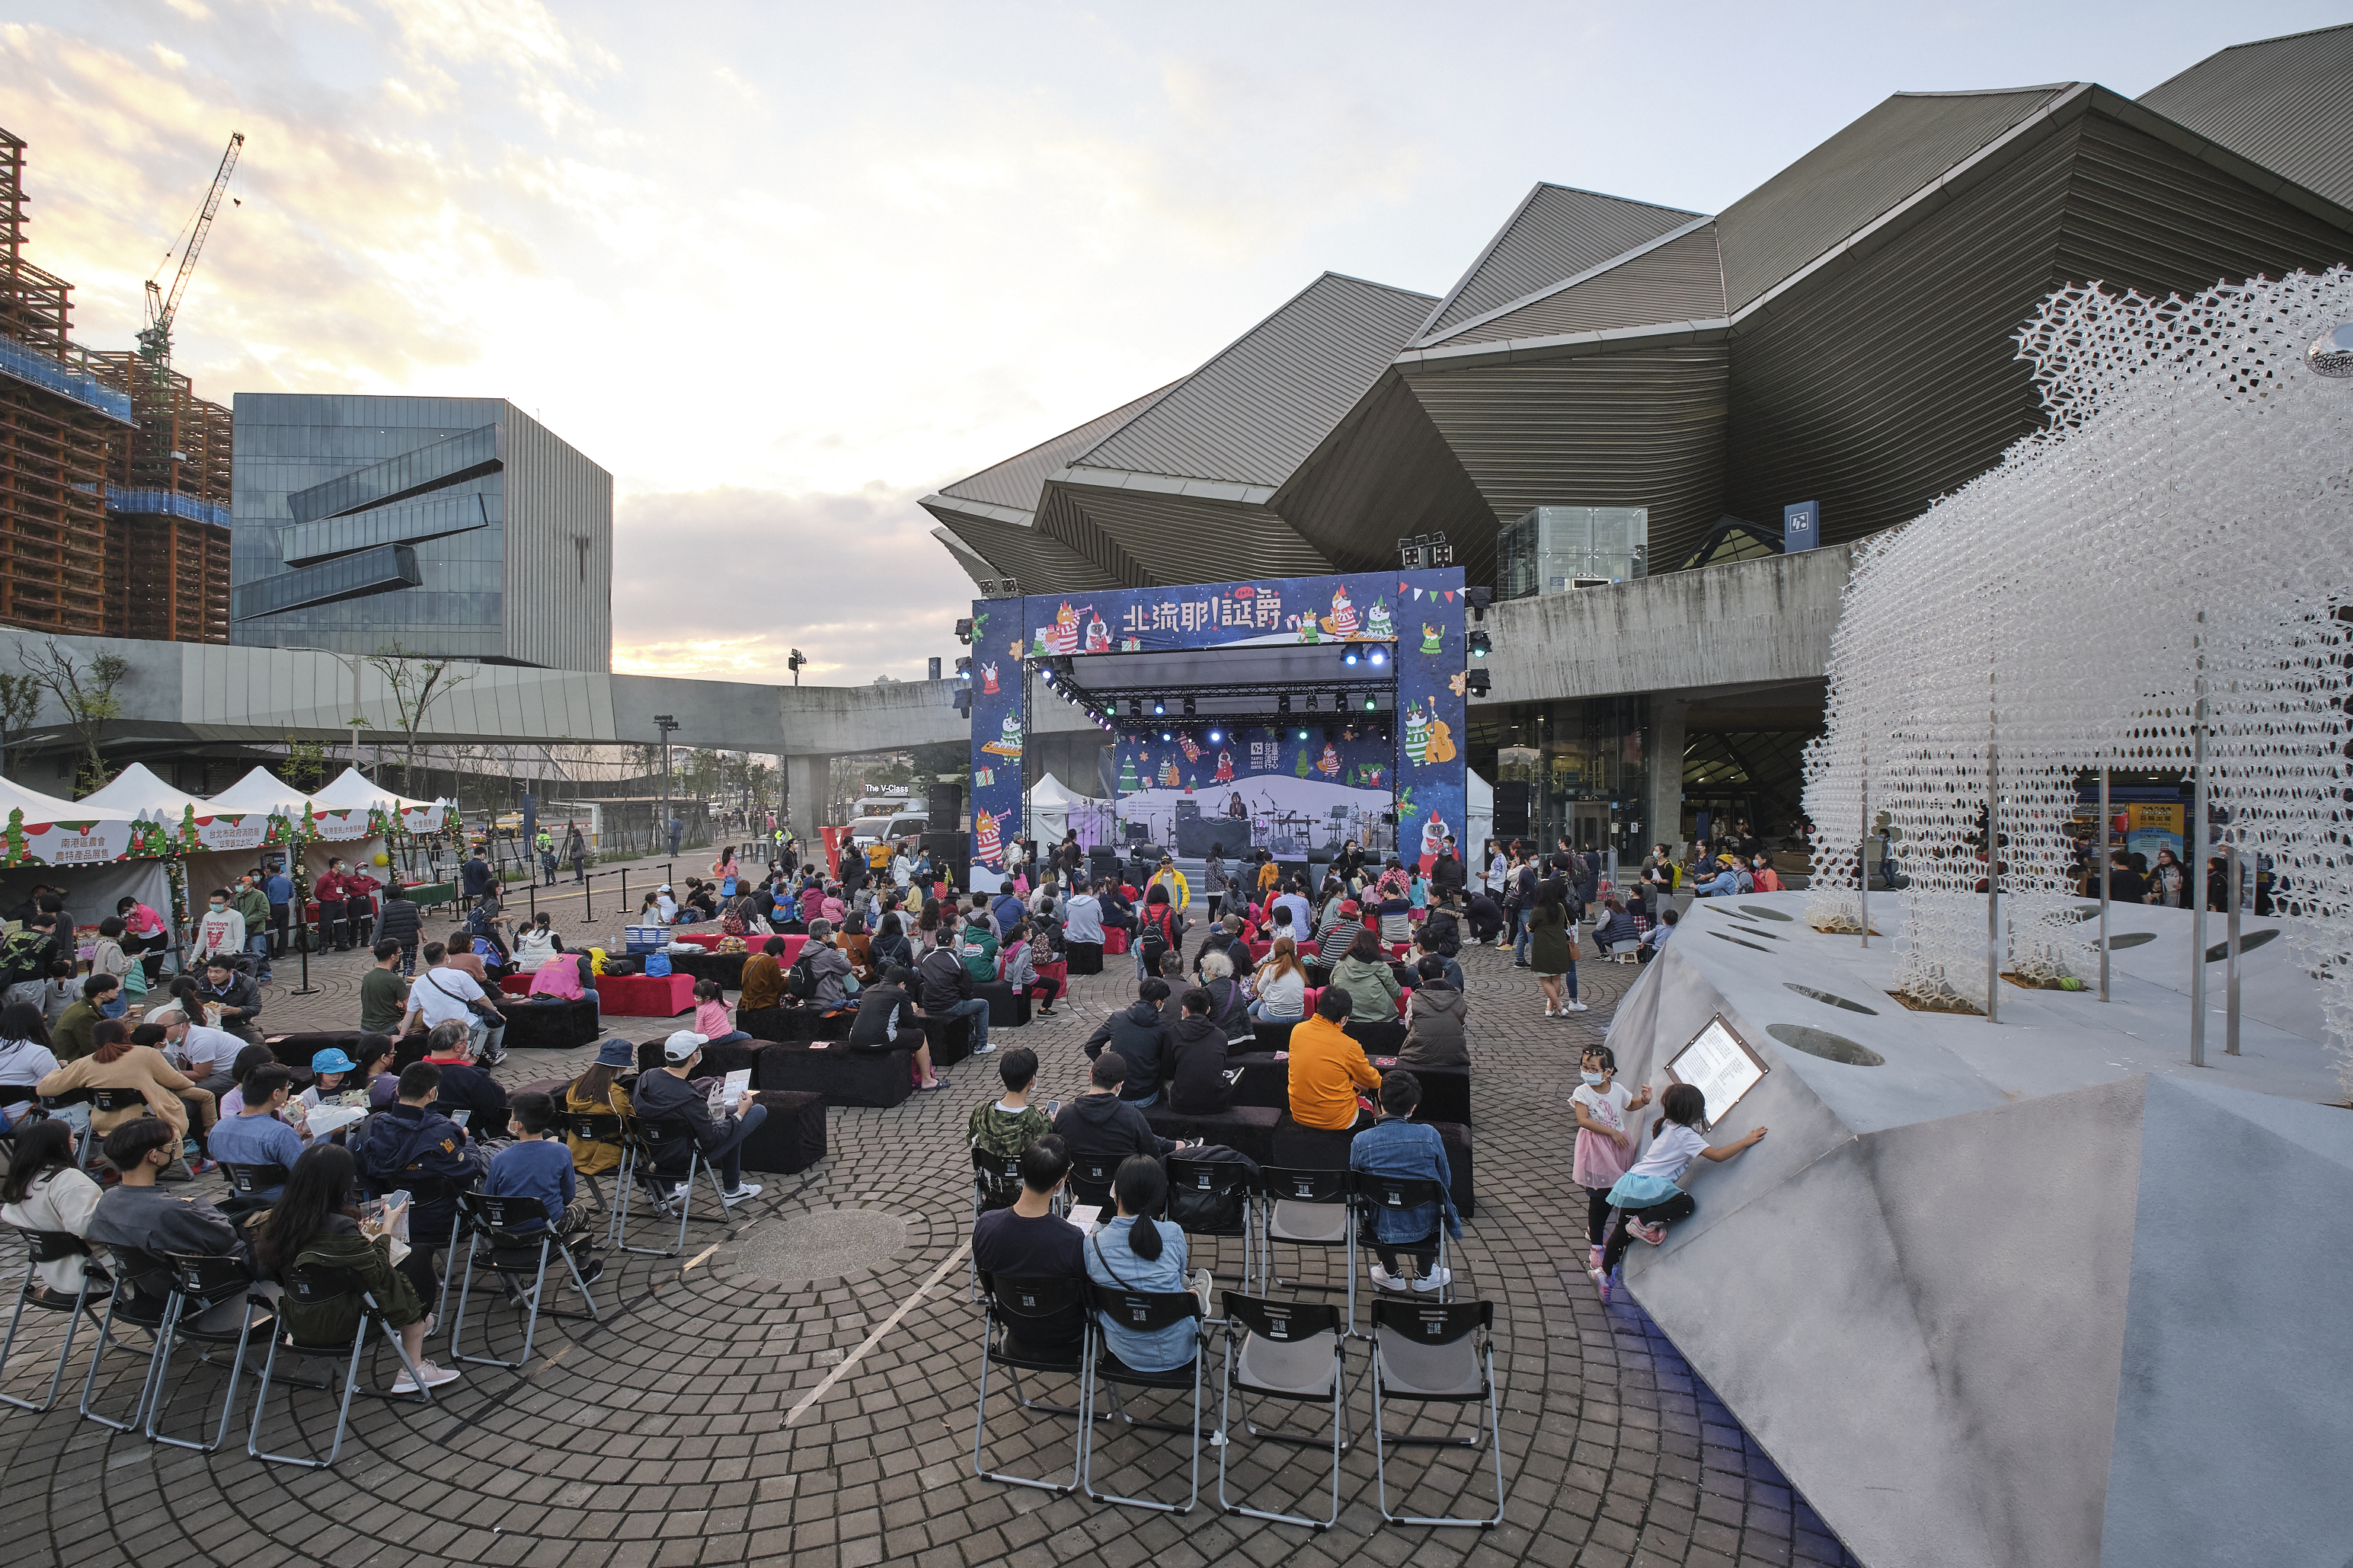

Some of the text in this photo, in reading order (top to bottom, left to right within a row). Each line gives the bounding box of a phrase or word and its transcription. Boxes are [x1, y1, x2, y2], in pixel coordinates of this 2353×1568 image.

[865, 784, 909, 793] The V-Class
[413, 820, 437, 829] 大會服務台
[209, 827, 259, 839] 台北市政府消防局
[61, 836, 105, 849] 南港區農會
[55, 848, 109, 862] 農特產品展售
